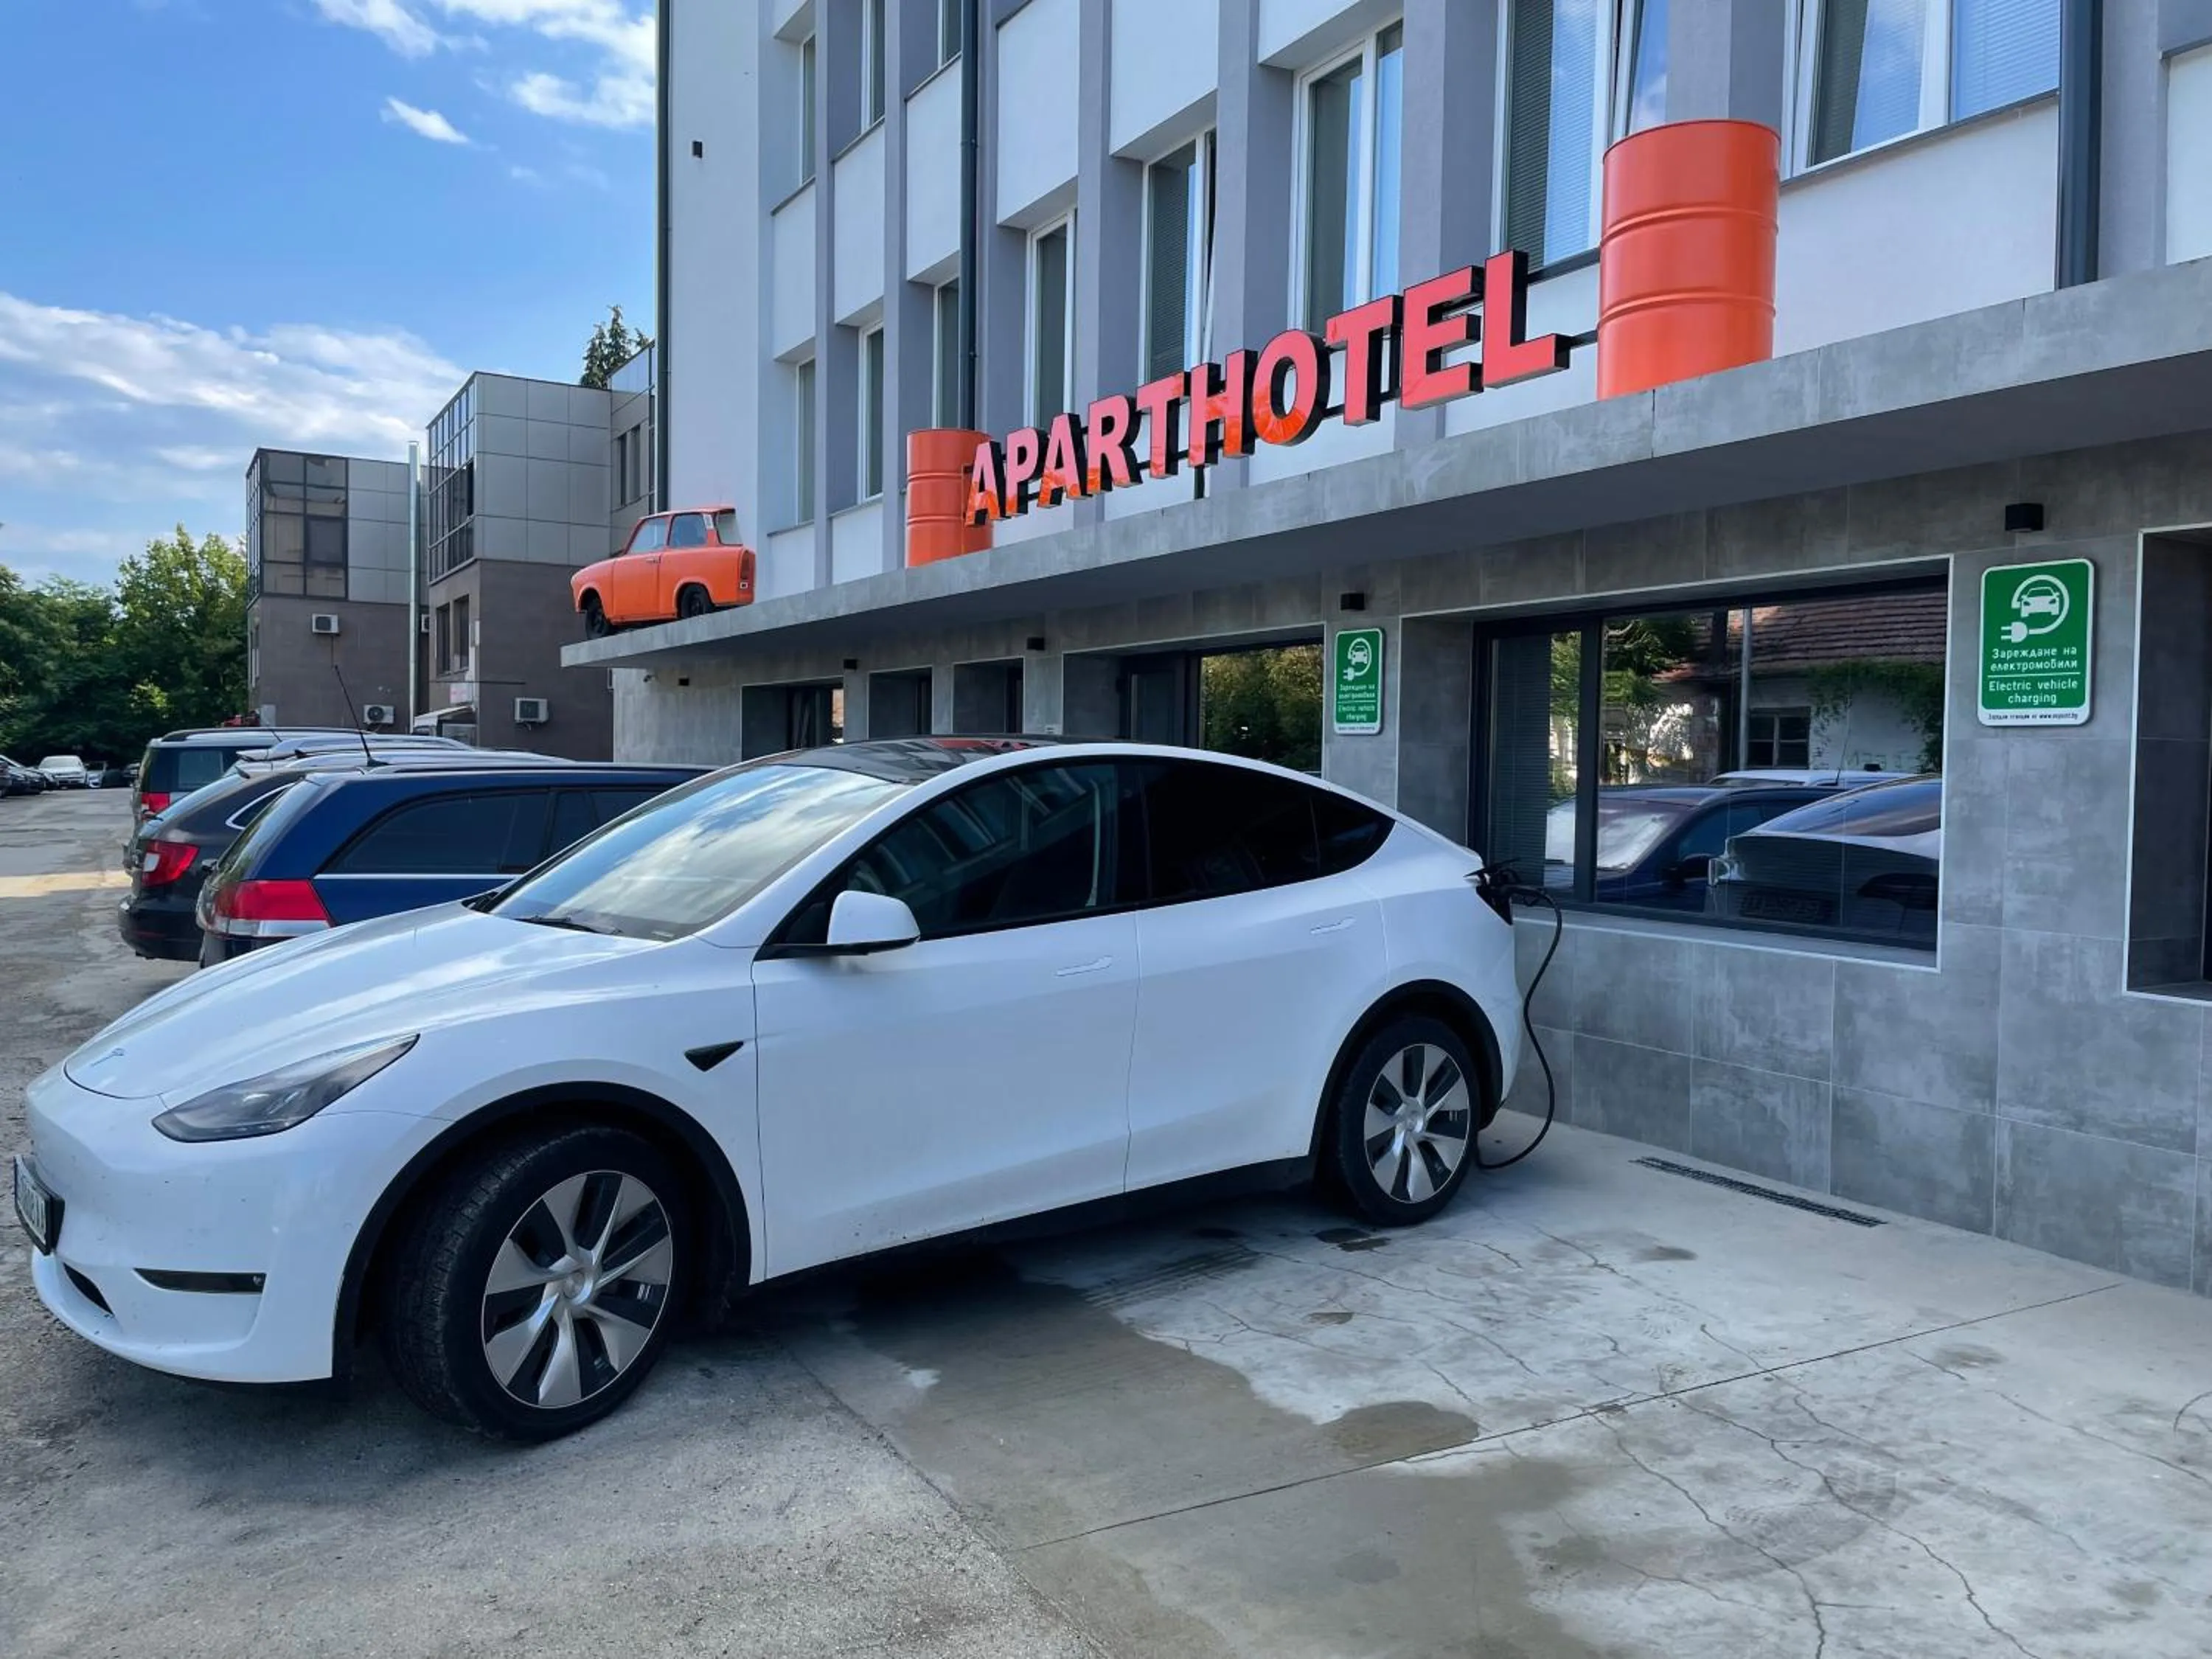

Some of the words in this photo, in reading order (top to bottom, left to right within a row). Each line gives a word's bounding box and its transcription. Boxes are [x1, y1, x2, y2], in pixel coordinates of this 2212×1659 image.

[964, 250, 1569, 525] APARTHOTEL
[1992, 648, 2057, 660] Зареждане
[2063, 647, 2077, 655] на
[1991, 659, 2078, 672] електромобили
[1989, 681, 2031, 692] Electric
[2037, 678, 2078, 690] vehicle
[2008, 693, 2057, 705] charging
